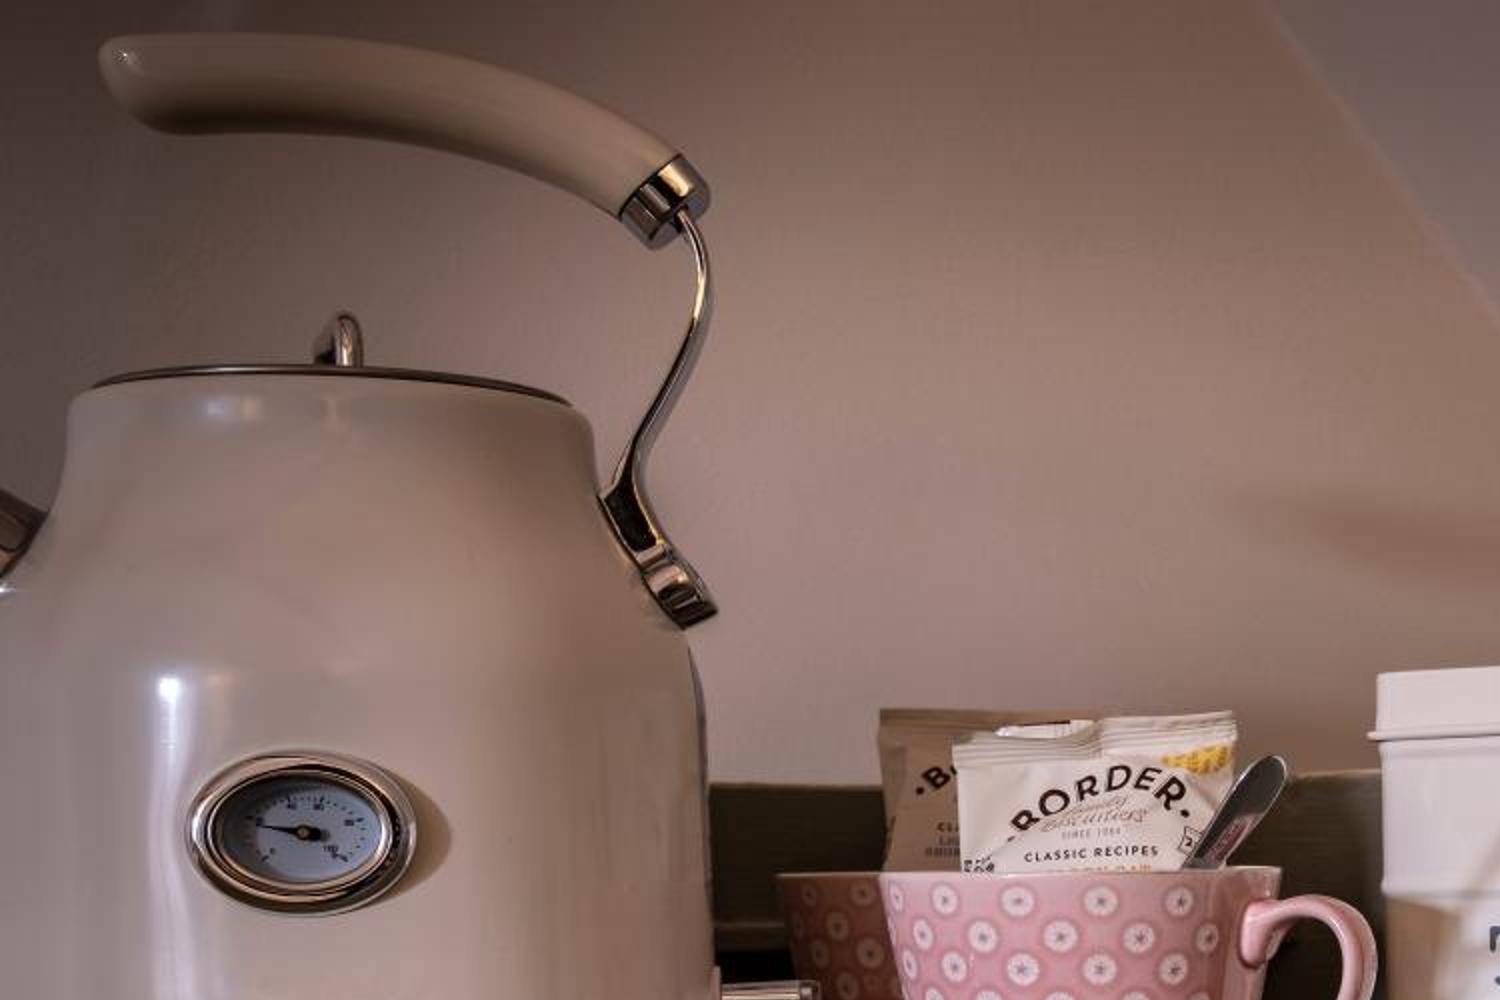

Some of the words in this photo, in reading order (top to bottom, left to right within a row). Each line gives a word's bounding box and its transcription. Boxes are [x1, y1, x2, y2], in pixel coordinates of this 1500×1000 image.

[1011, 765, 1187, 831] BORDER
[1024, 848, 1088, 863] CLASSIC
[1093, 844, 1159, 858] RECIPES
